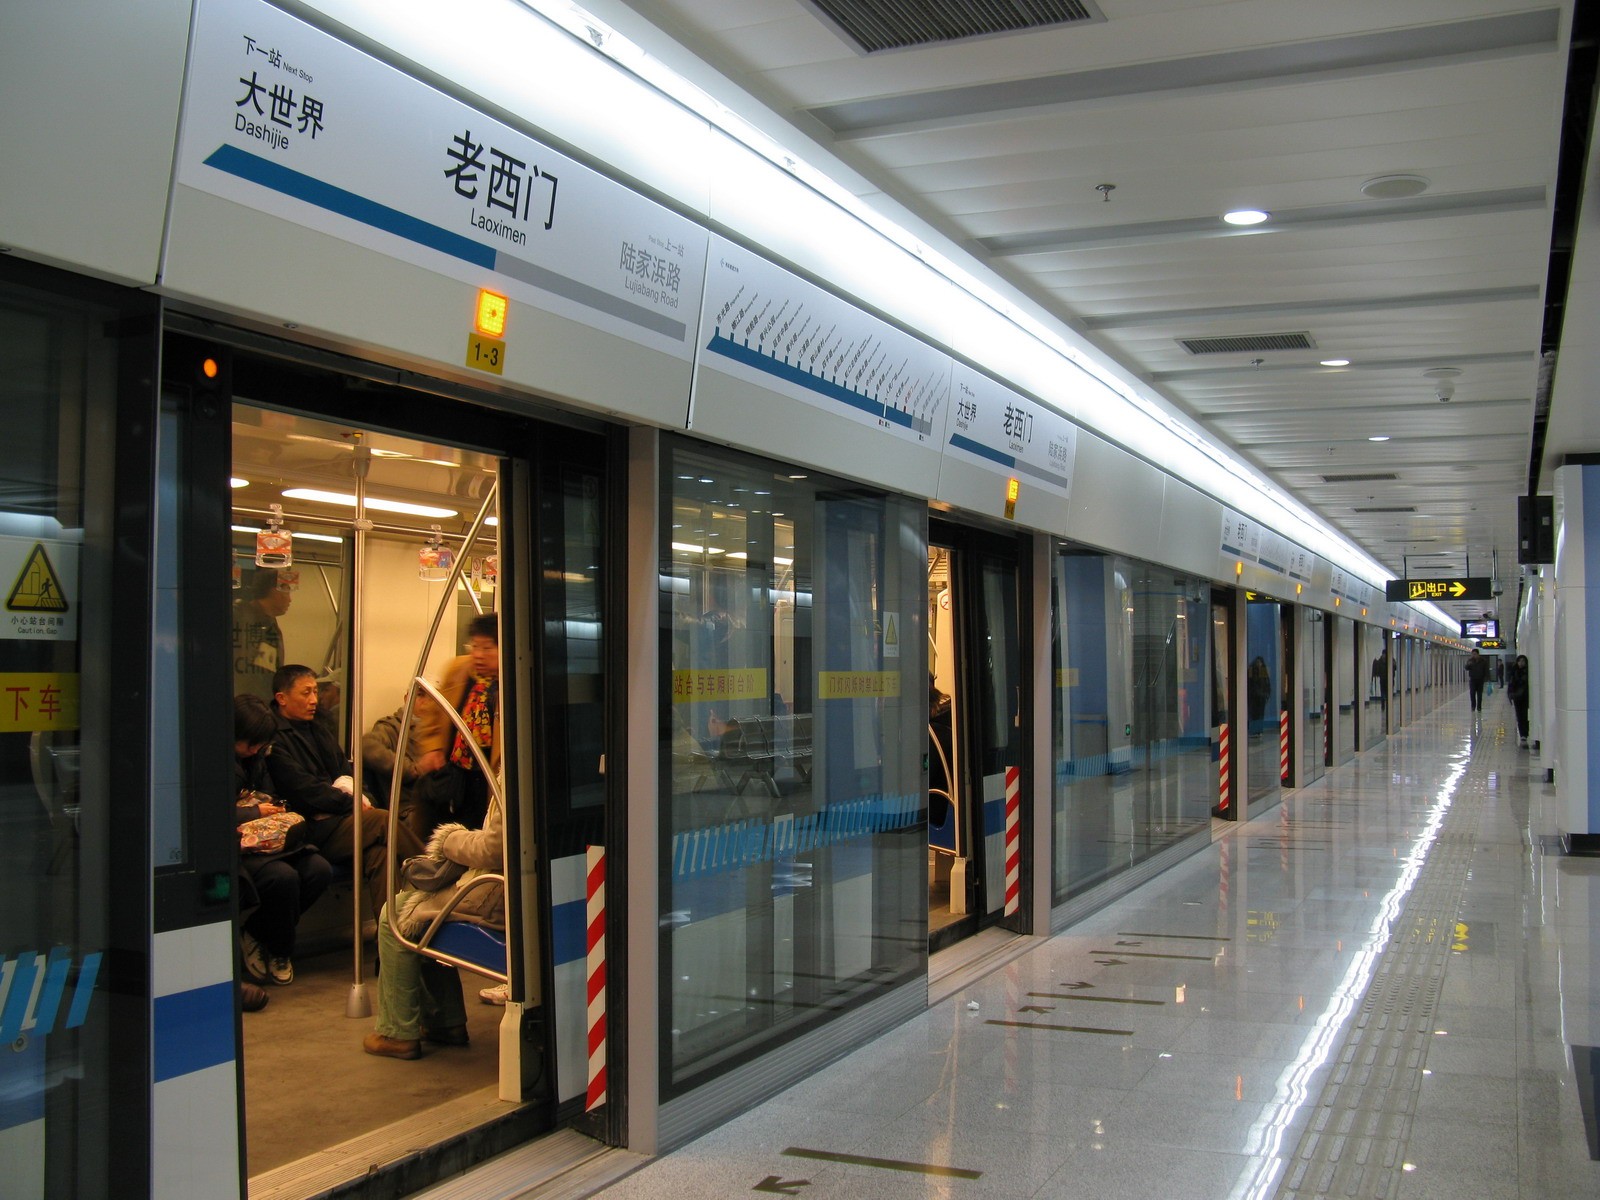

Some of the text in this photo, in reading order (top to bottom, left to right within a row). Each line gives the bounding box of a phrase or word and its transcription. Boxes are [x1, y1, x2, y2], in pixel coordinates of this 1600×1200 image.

[243, 36, 282, 69] 下一站
[282, 61, 314, 84] Next Stop
[235, 71, 325, 140] 大世界
[235, 113, 290, 151] Dashijie
[444, 130, 559, 230] 老西门
[470, 208, 527, 247] Laoximen
[665, 238, 685, 258] 上一站
[619, 241, 681, 294] 陆家浜路
[625, 276, 679, 309] Lujiabang Road
[473, 342, 499, 368] 1-3
[957, 398, 977, 423] 大世界
[1003, 402, 1033, 443] 老西门
[1427, 582, 1447, 593] 出口
[5, 684, 62, 721] 下车
